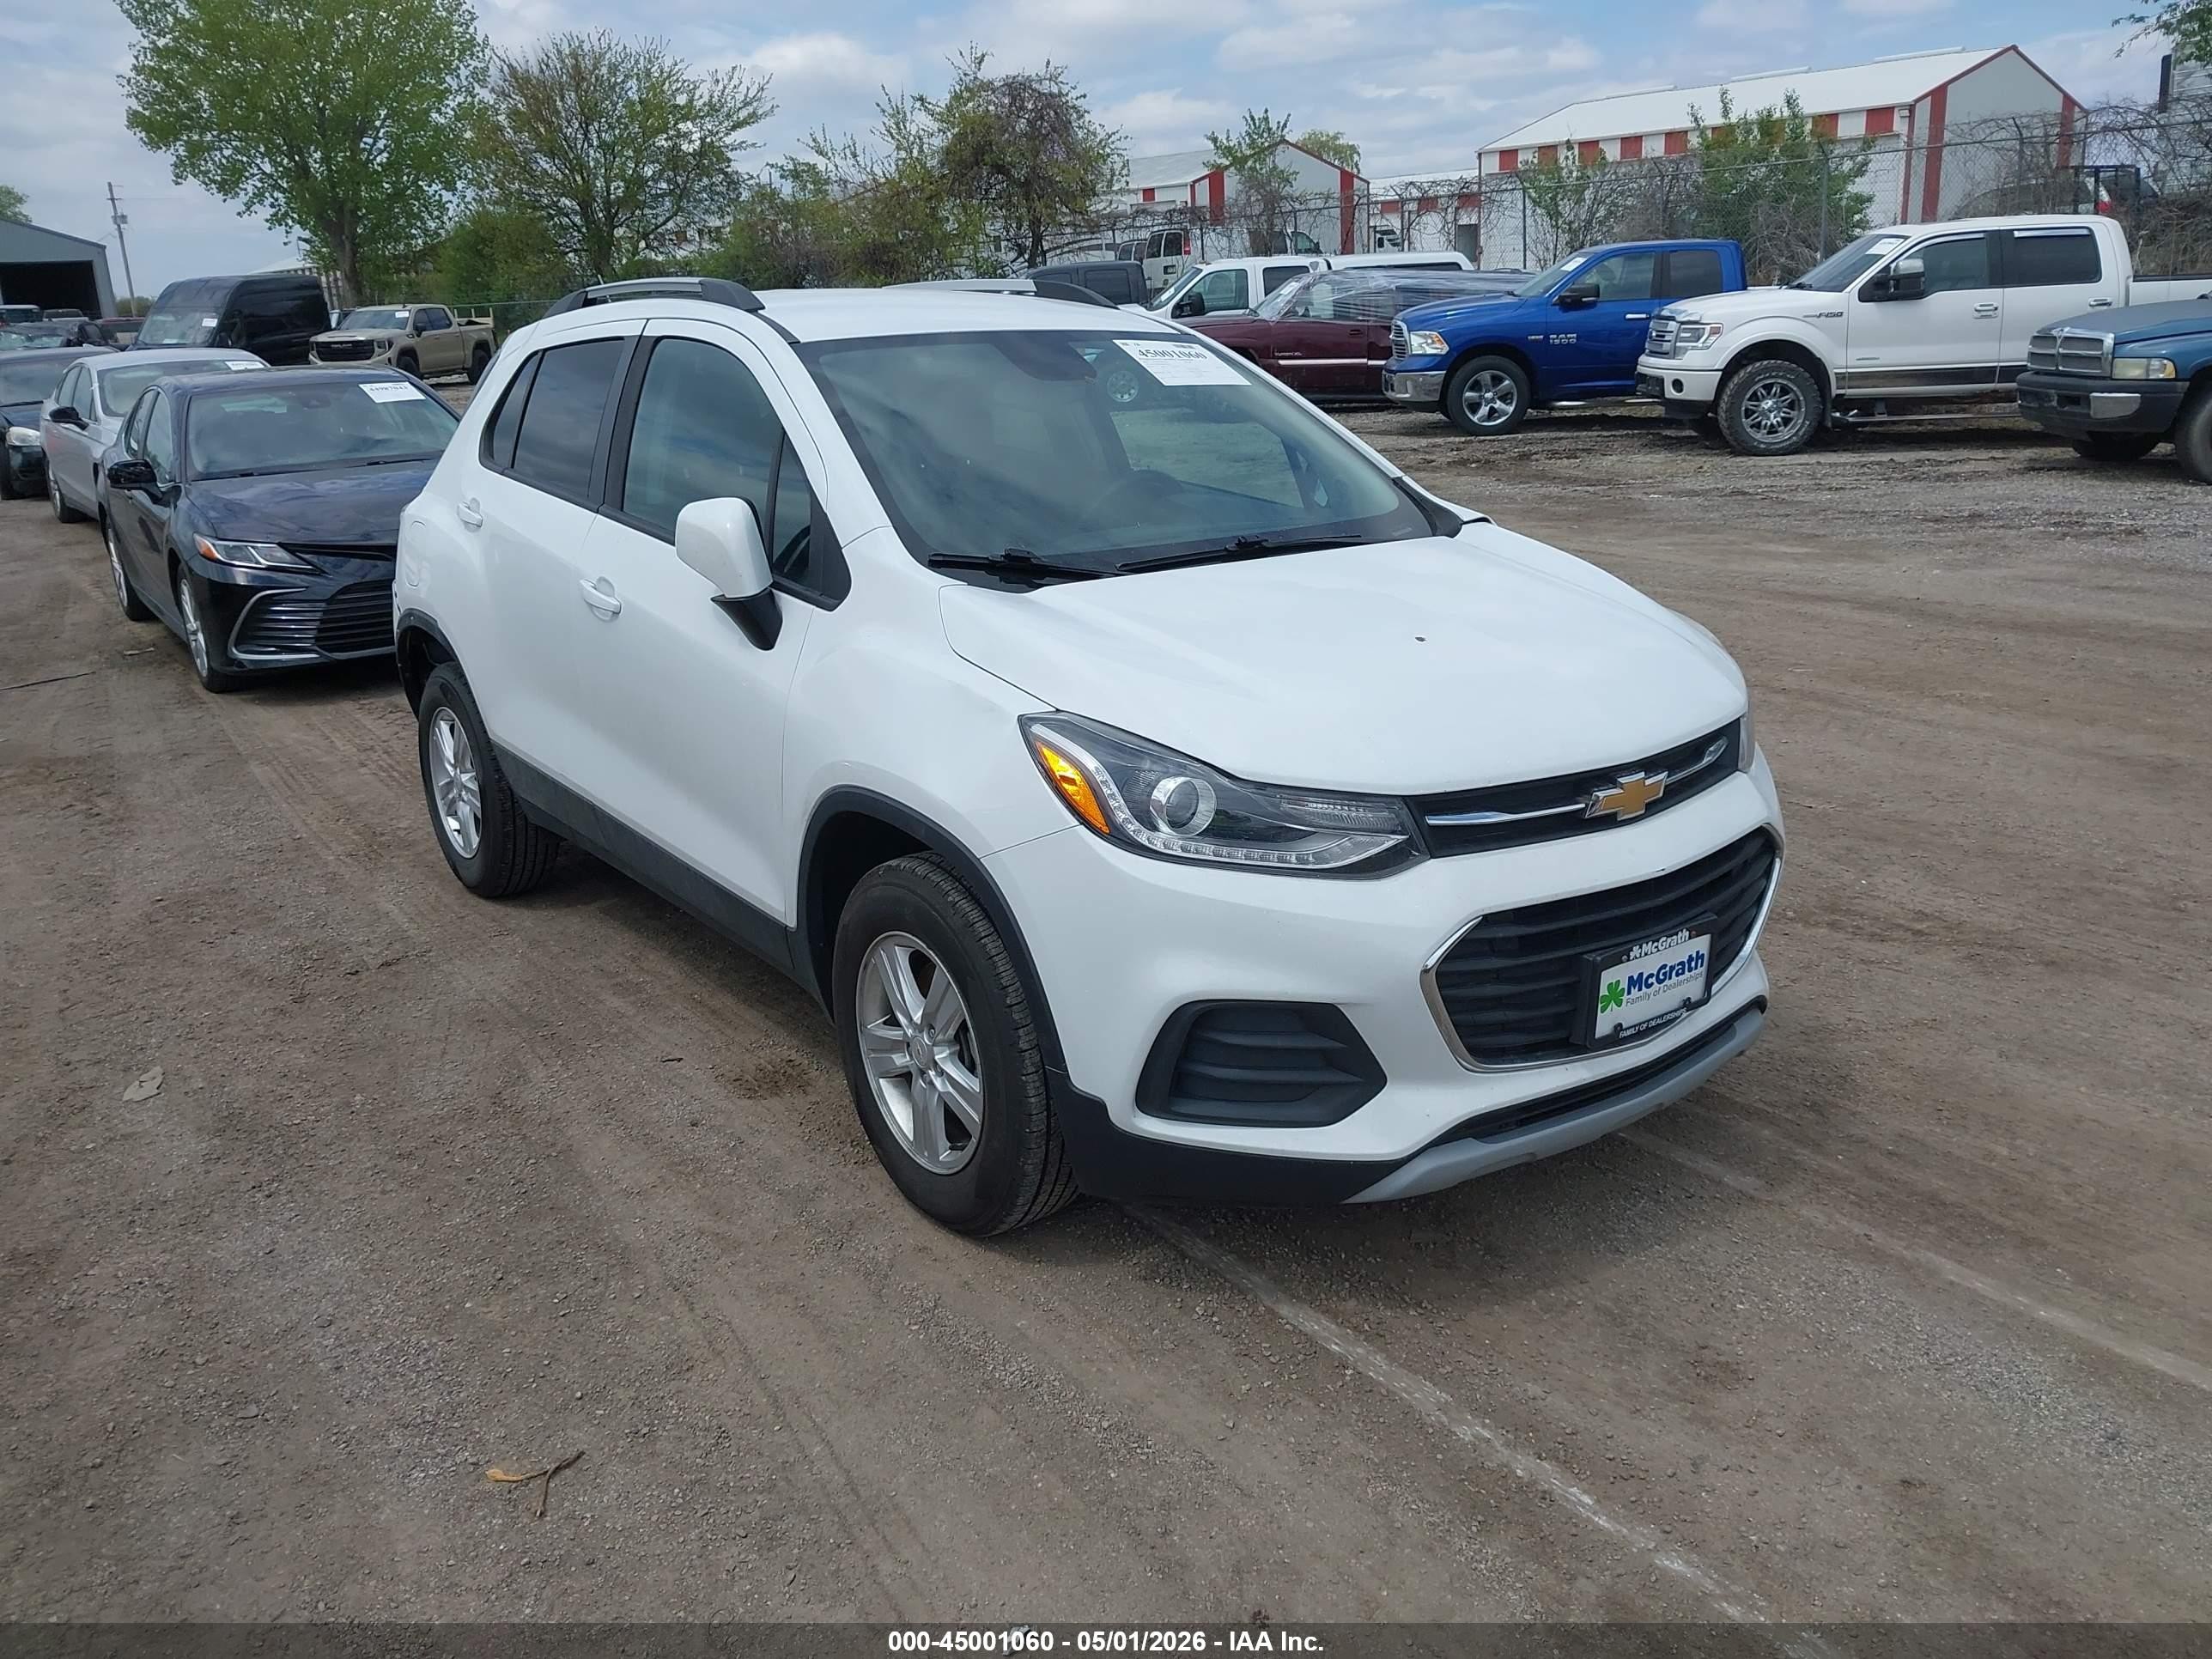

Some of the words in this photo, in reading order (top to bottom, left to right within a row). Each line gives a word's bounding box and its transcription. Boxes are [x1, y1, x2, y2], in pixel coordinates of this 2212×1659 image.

[1138, 349, 1207, 359] 45001060
[1641, 928, 1690, 957] McGrath
[1626, 949, 1705, 996] McGrath
[1626, 991, 1652, 1007] Family
[1652, 987, 1662, 997] of
[1662, 971, 1704, 994] Dealerships
[1619, 1025, 1639, 1038] FAMILY
[1639, 1022, 1649, 1031] OF
